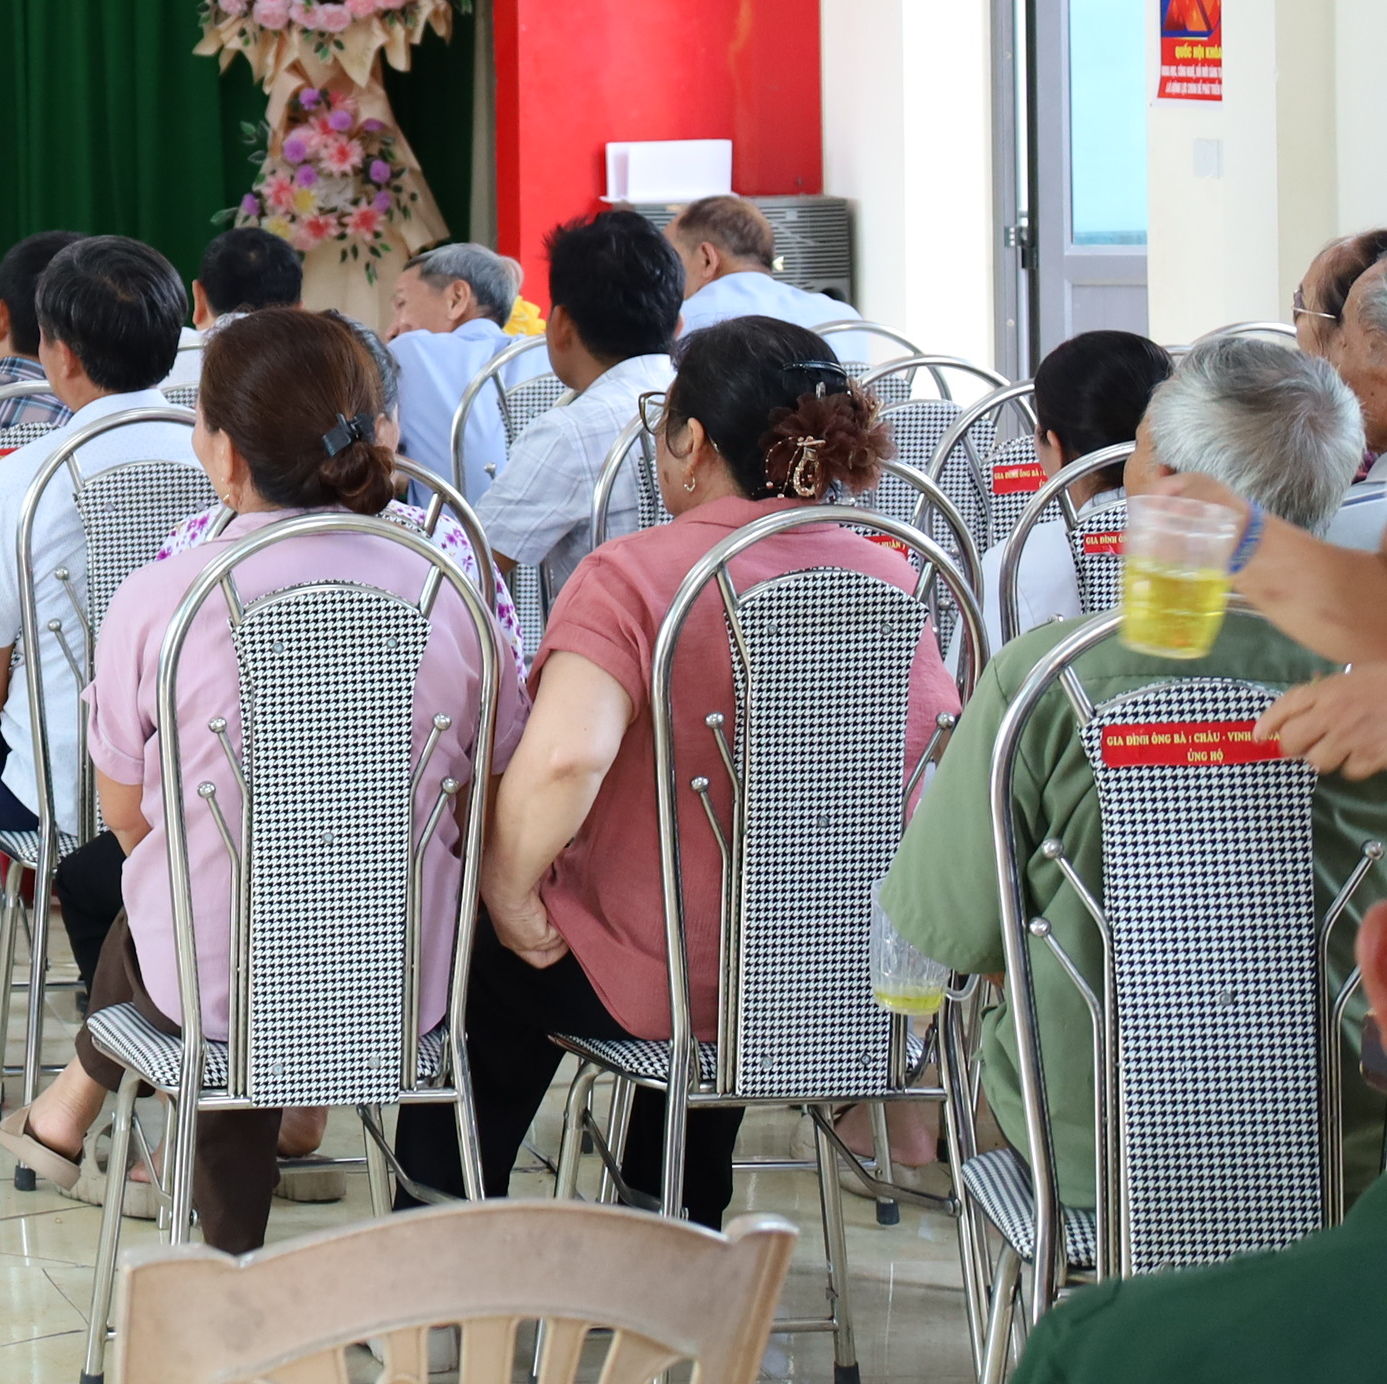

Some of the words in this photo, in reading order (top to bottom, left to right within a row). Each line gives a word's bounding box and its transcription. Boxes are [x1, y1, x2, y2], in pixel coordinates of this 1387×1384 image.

[1107, 735, 1124, 746] GIA
[1151, 732, 1171, 744] ÔNG
[1173, 731, 1187, 744] BÀ
[1193, 729, 1220, 743] CHÂU
[1227, 731, 1252, 742] VINH
[1210, 749, 1224, 764] HỘ
